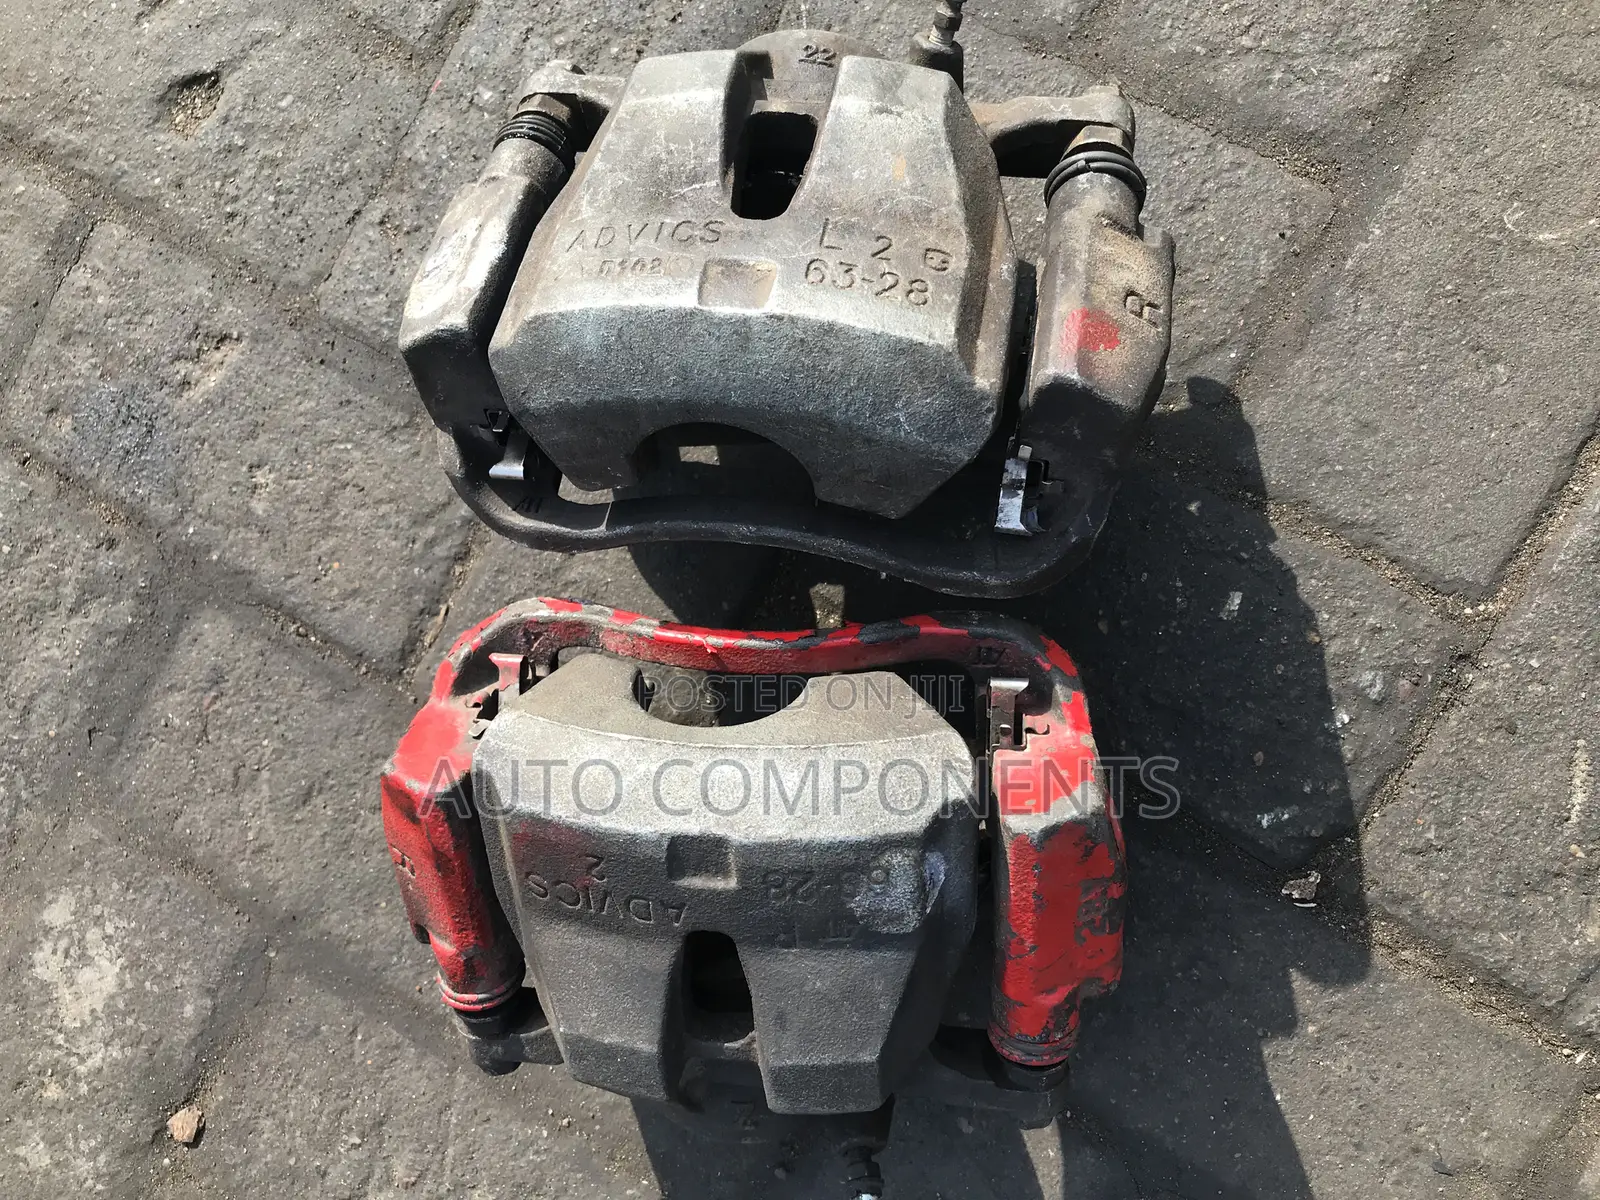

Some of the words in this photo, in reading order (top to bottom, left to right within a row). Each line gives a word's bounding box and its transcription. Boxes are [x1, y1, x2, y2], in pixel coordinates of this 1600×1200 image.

[799, 44, 838, 68] 22
[566, 219, 727, 254] ADVICS
[819, 217, 844, 252] L
[870, 234, 894, 262] 2
[804, 257, 931, 306] 63-28
[1122, 289, 1164, 331] R
[584, 856, 608, 882] 2
[523, 872, 690, 928] ADVICS
